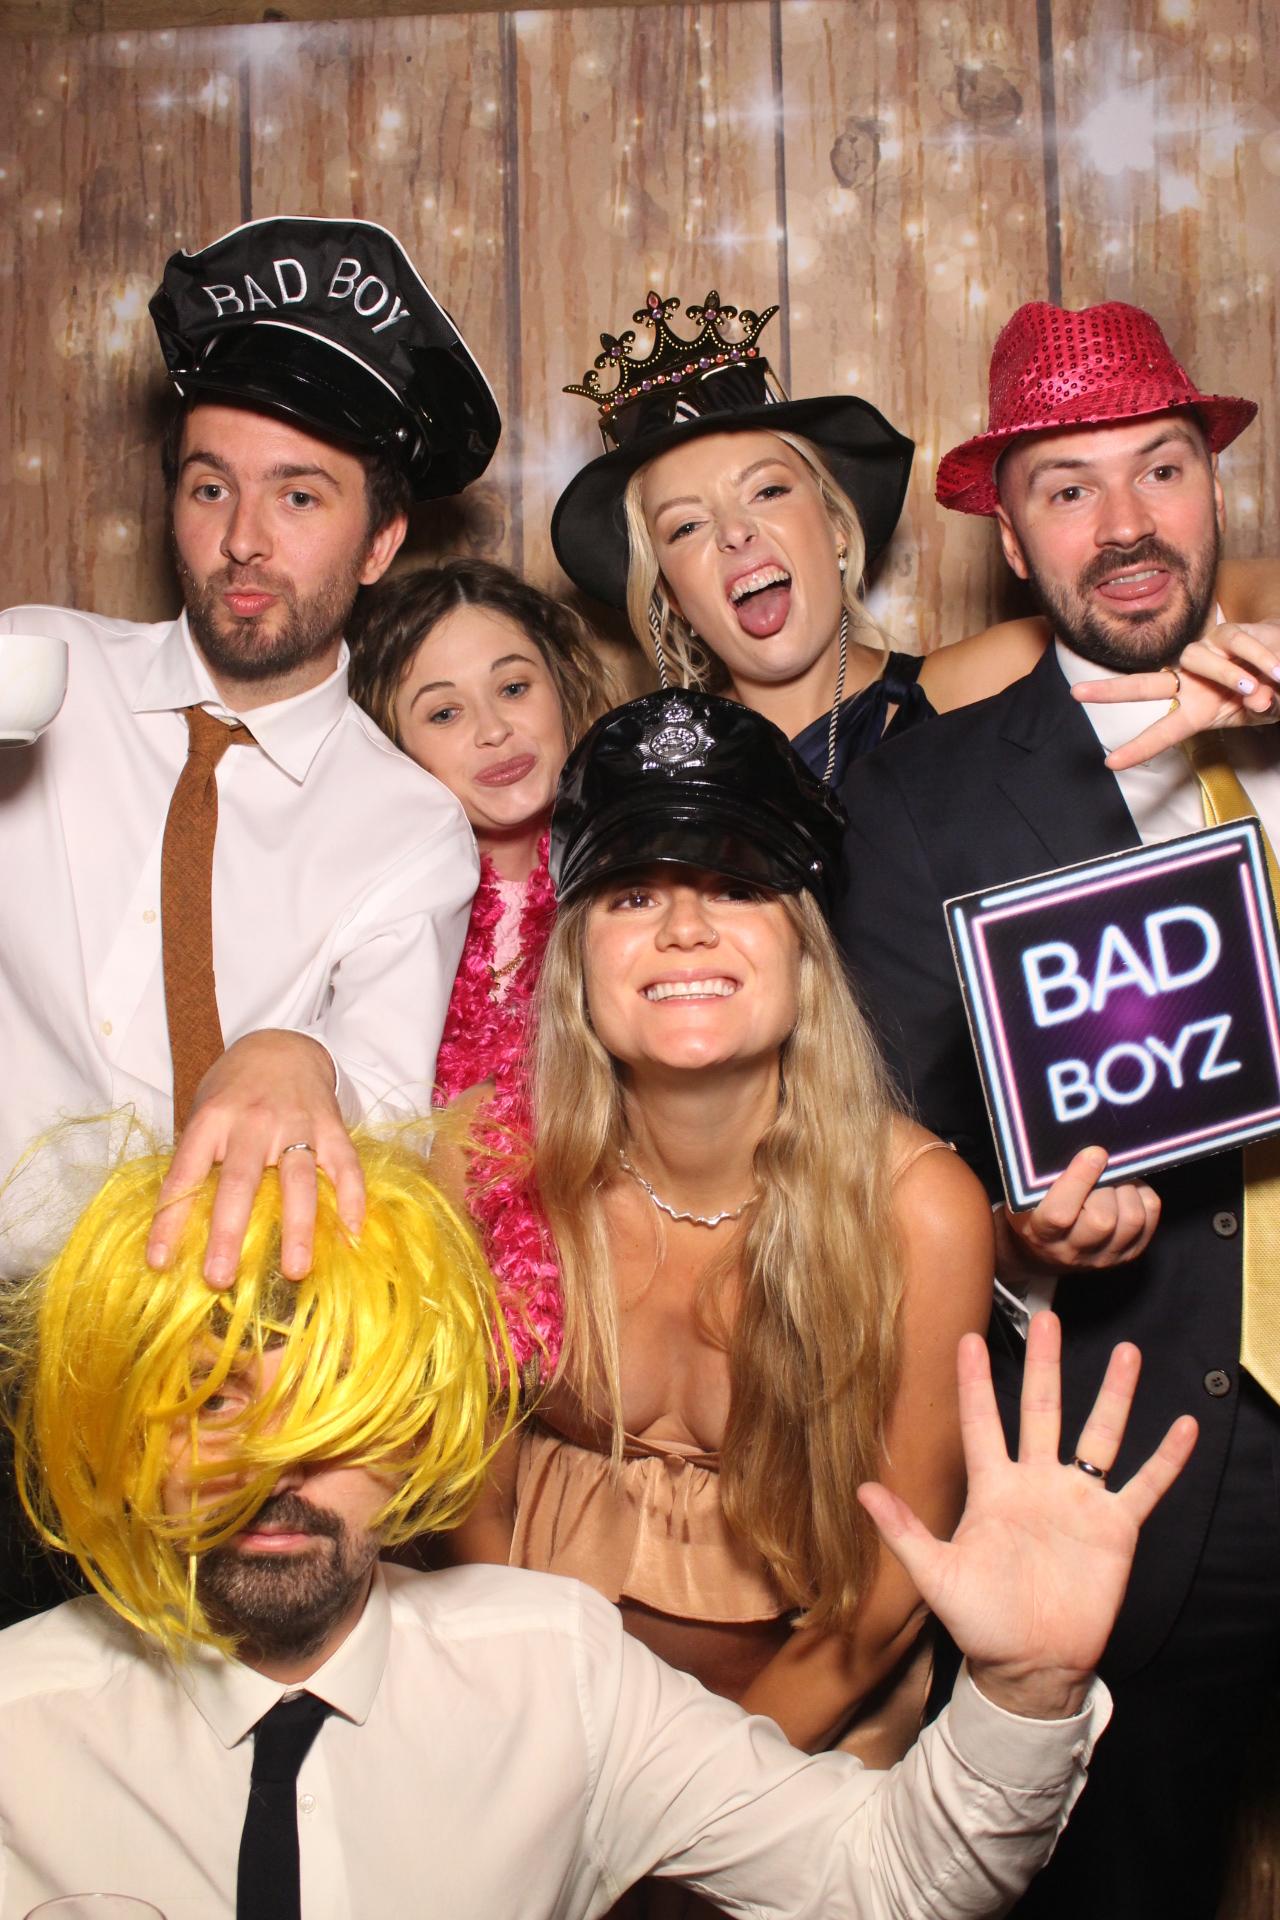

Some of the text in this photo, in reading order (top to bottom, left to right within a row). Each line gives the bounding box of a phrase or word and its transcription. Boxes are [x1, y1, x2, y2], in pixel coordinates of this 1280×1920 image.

[202, 257, 411, 335] BAD BOY
[1021, 905, 1222, 1028] BAD
[1046, 1013, 1242, 1123] BOYZ
